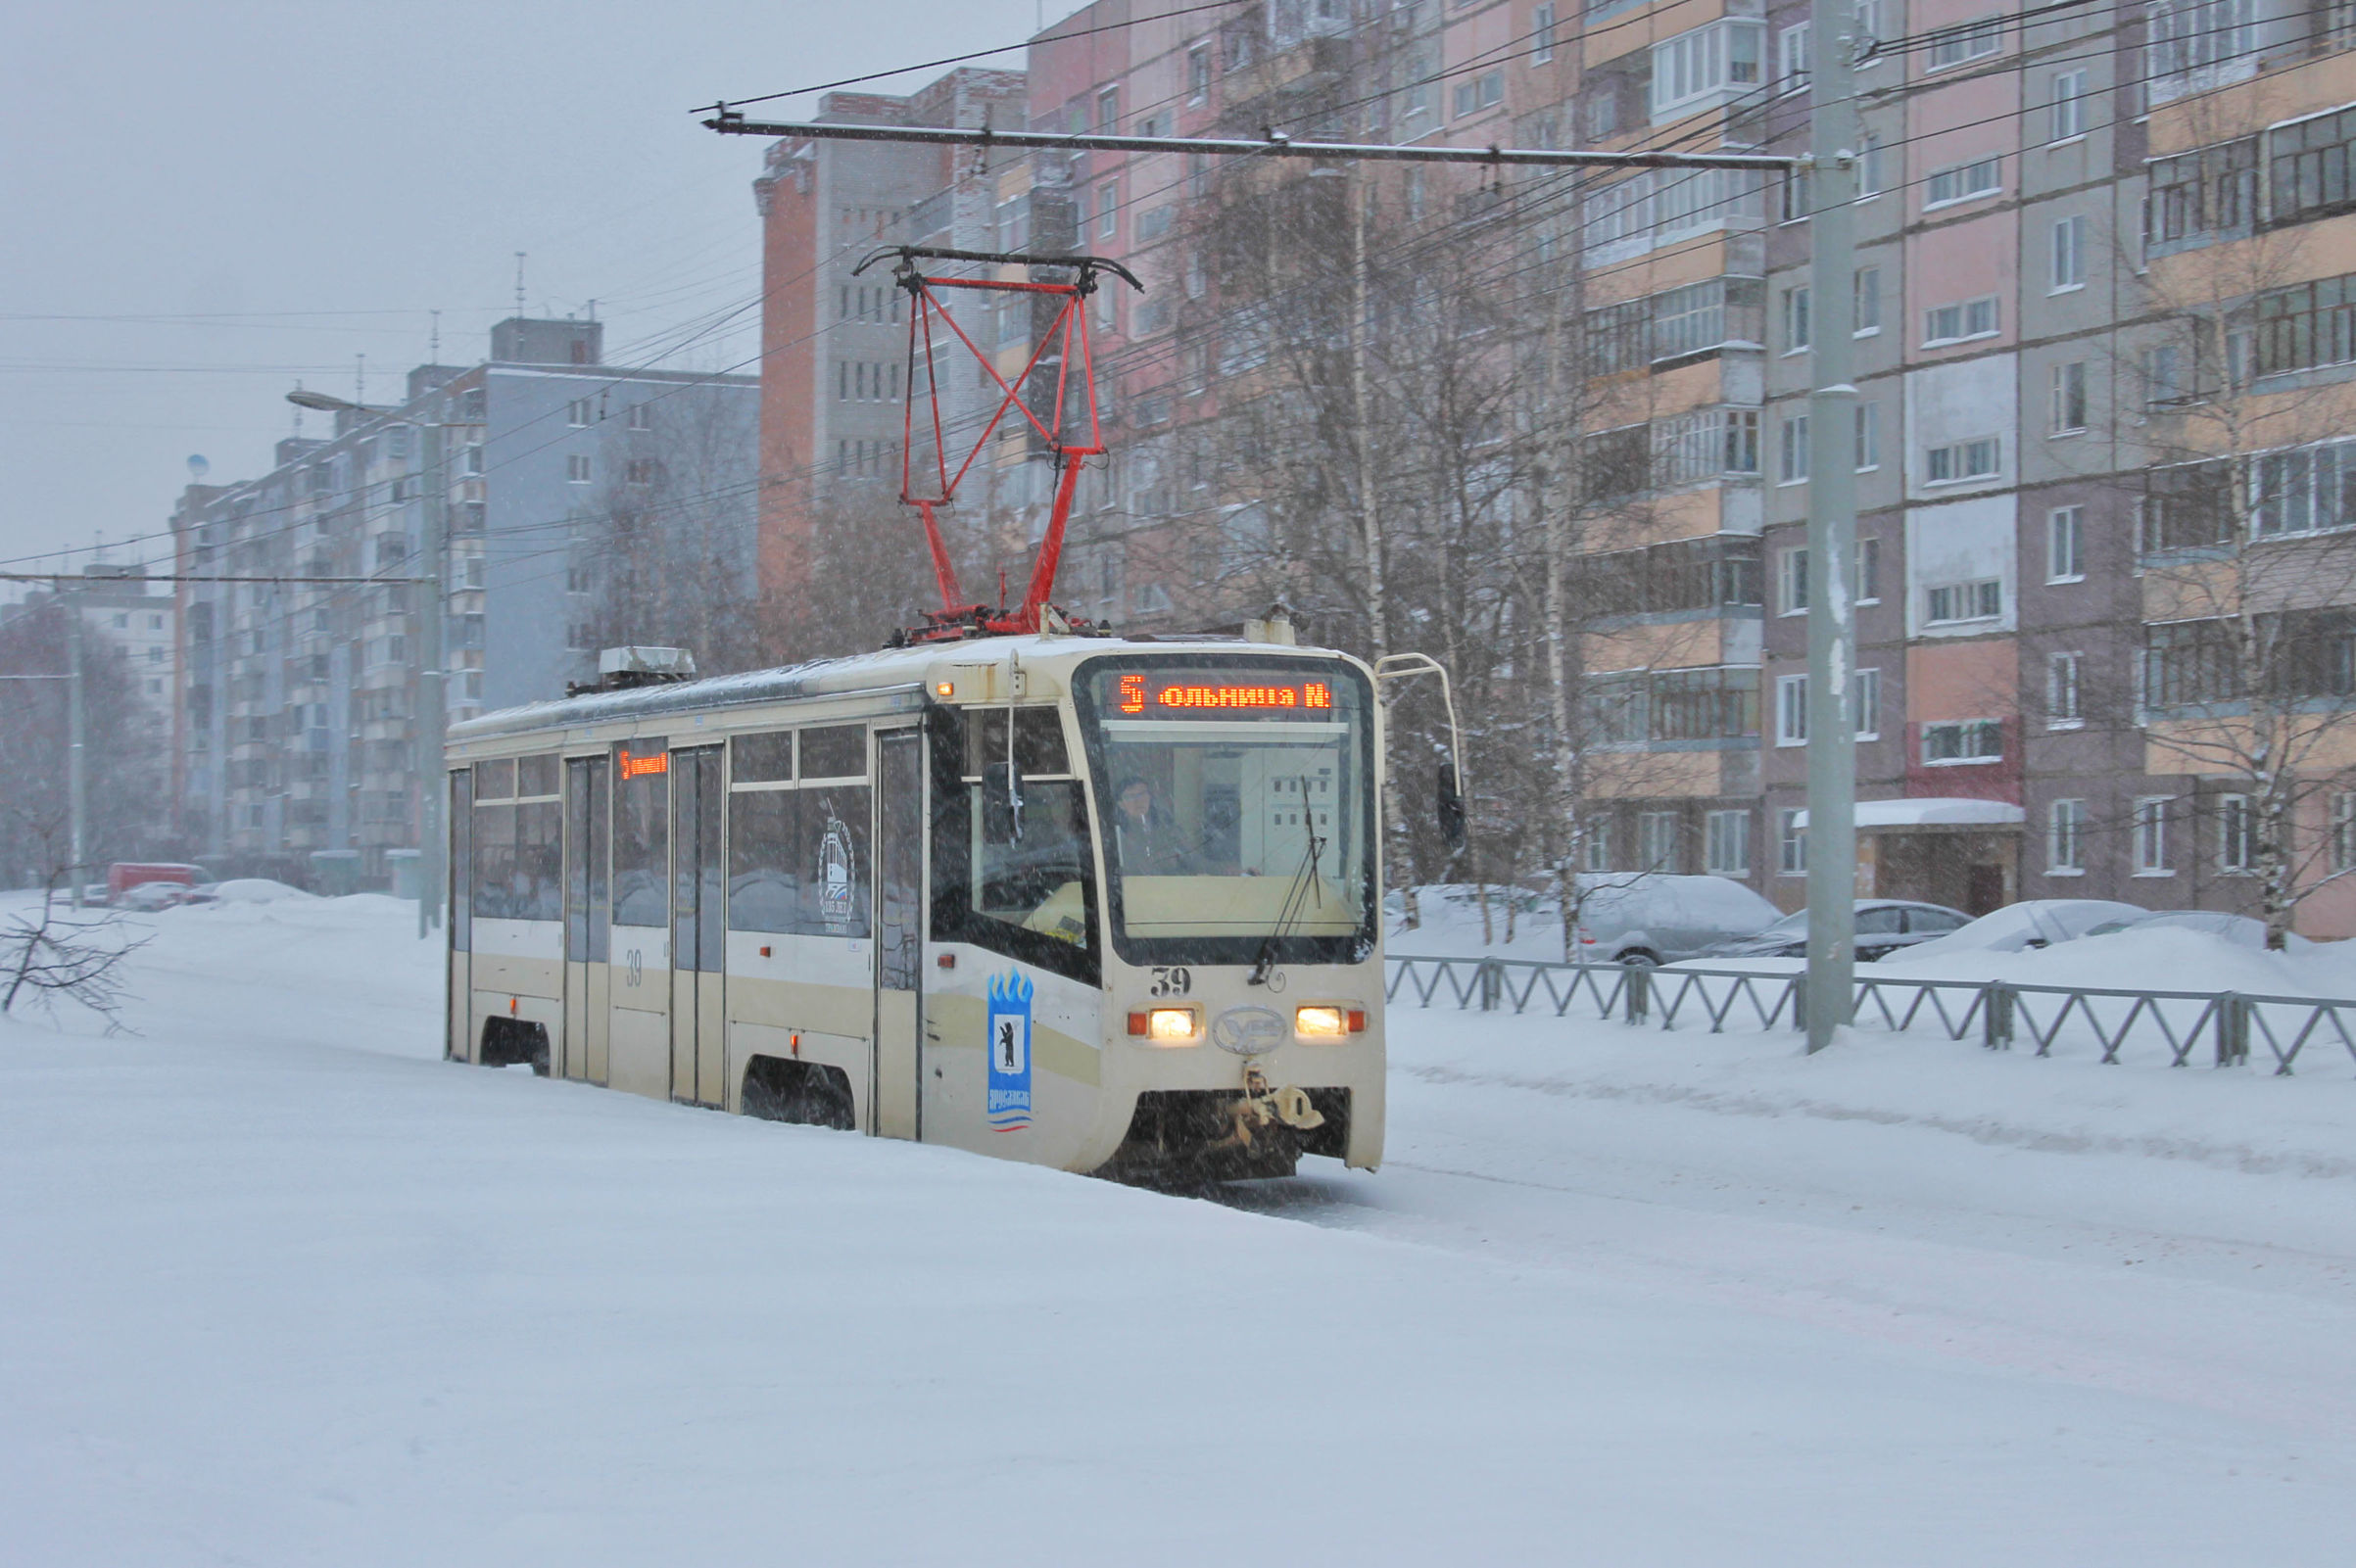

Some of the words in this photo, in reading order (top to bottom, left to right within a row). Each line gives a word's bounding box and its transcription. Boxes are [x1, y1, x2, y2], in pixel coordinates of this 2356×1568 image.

[1120, 675, 1144, 712] 5
[1159, 687, 1296, 706] ольница
[627, 949, 642, 987] 39
[1150, 966, 1191, 997] 39
